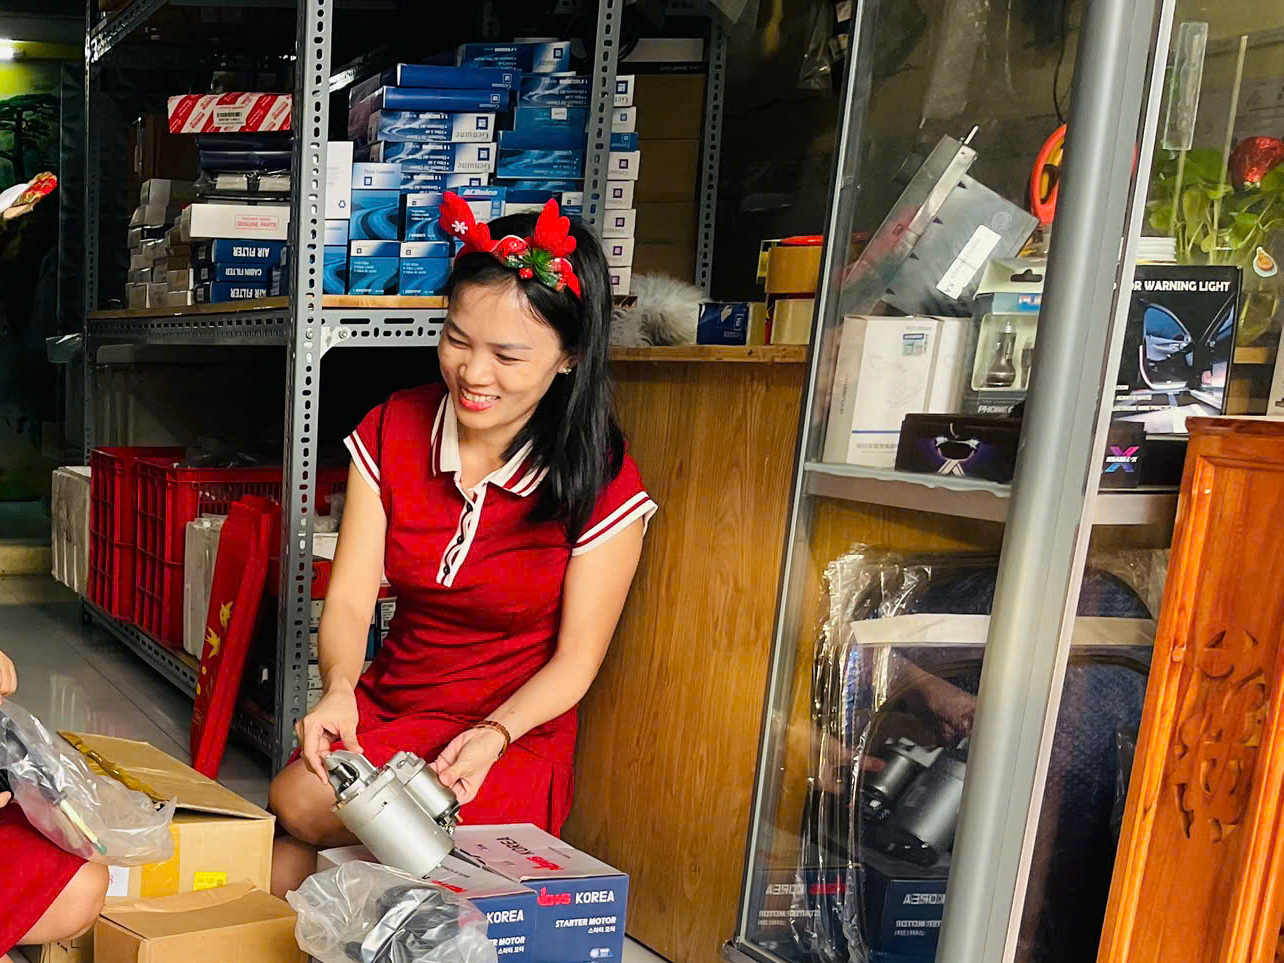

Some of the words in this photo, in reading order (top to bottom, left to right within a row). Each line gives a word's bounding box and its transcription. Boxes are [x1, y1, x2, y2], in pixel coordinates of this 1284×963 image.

[454, 131, 489, 140] Genuine
[457, 162, 491, 171] Genuine
[232, 247, 256, 257] FILTER
[257, 247, 270, 258] AIR
[225, 268, 244, 276] FILTER
[245, 268, 262, 276] CABIN
[1144, 280, 1197, 292] WARNING
[1198, 281, 1231, 292] LIGHT
[230, 288, 253, 298] FILTER
[254, 288, 267, 298] AIR
[977, 404, 1007, 413] PHONE
[575, 890, 615, 905] KOREA
[486, 909, 524, 924] KOREA
[555, 918, 588, 928] STARTER
[588, 916, 617, 926] MOTOR
[498, 936, 526, 946] MOTOR
